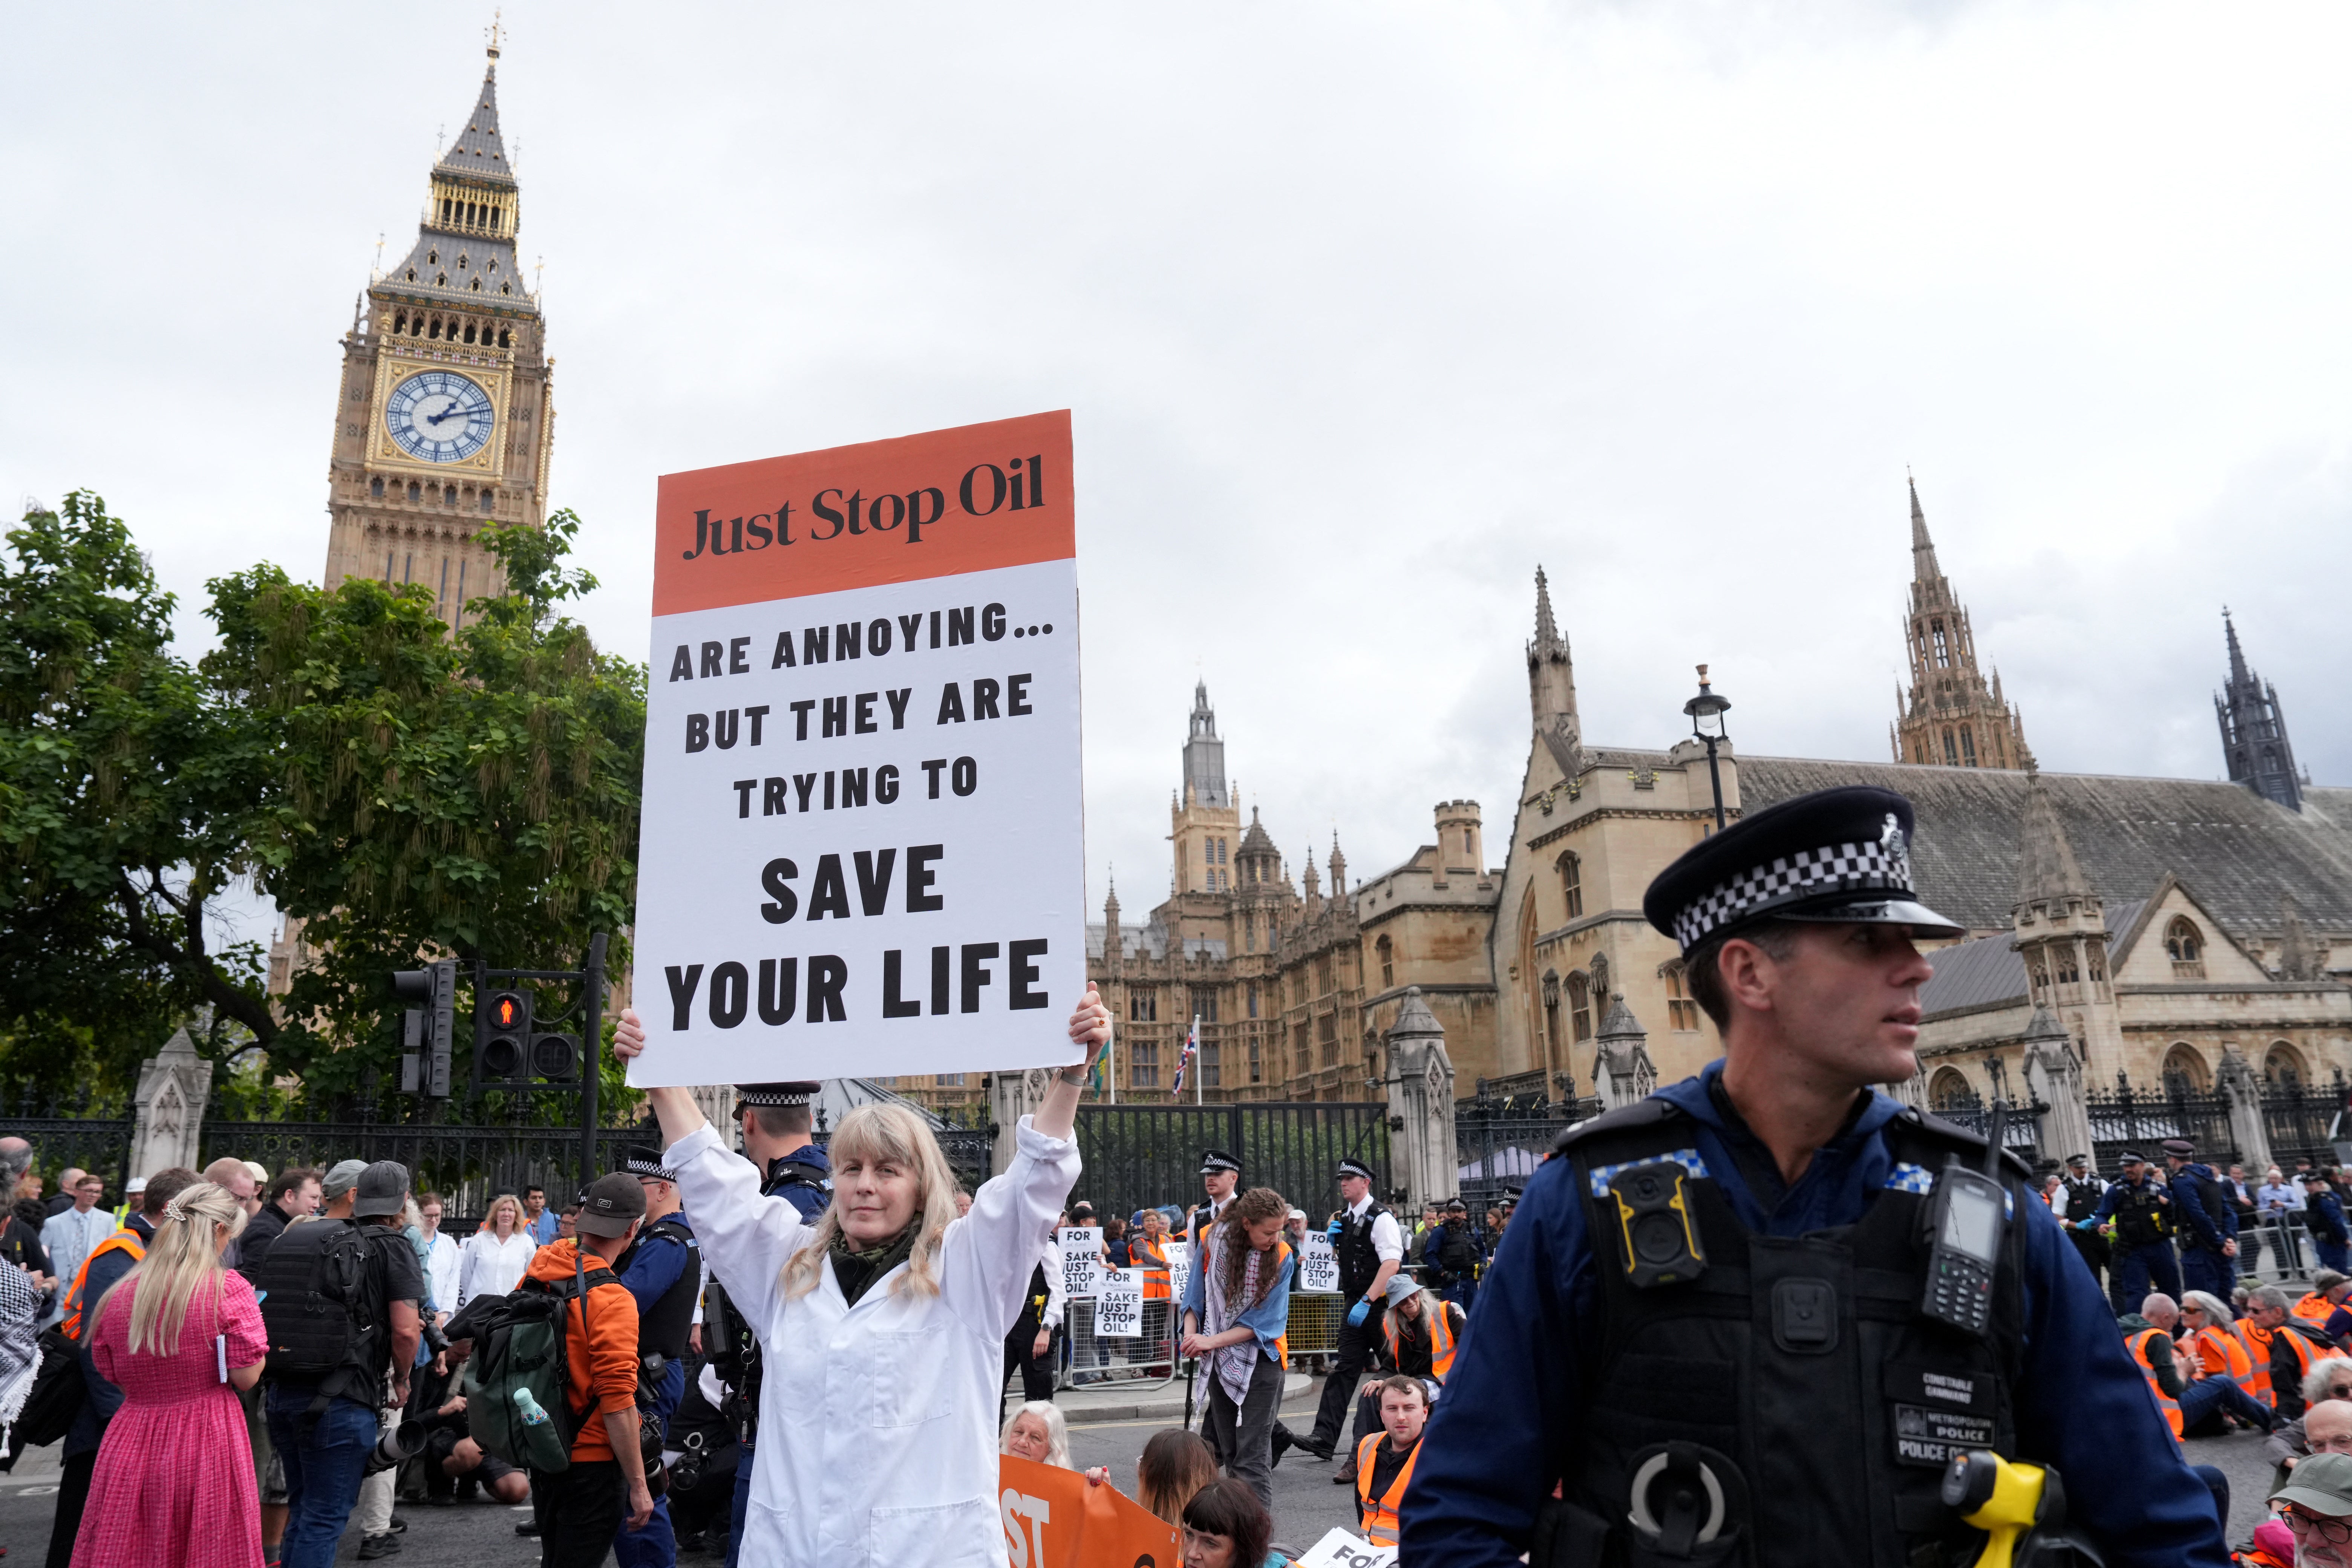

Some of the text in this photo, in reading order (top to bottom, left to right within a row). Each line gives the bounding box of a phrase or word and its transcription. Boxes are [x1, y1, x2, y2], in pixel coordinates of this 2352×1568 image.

[683, 455, 1046, 560] Just Stop Oil
[670, 603, 1053, 682] ARE ANNOYING...
[686, 674, 1032, 753] BUT THEY ARE
[733, 756, 977, 819] TRYING TO
[761, 844, 943, 924] SAVE
[665, 938, 1048, 1031] YOUR LIFE
[1067, 1231, 1090, 1241] FOR
[1066, 1251, 1097, 1262] SAKE
[1174, 1263, 1188, 1272] SA
[1303, 1260, 1329, 1271] JUST
[1065, 1272, 1095, 1283] STOP
[1106, 1271, 1130, 1282] FOR
[1308, 1270, 1334, 1279] STOP
[1065, 1283, 1088, 1293] OIL!
[1308, 1278, 1327, 1288] OIL!
[1105, 1292, 1138, 1303] SAKE
[1098, 1302, 1130, 1314] JUST
[1103, 1312, 1136, 1323] STOP
[1103, 1323, 1128, 1333] OIL!
[1936, 1426, 1985, 1442] POLICE
[1898, 1439, 1946, 1462] POLICE
